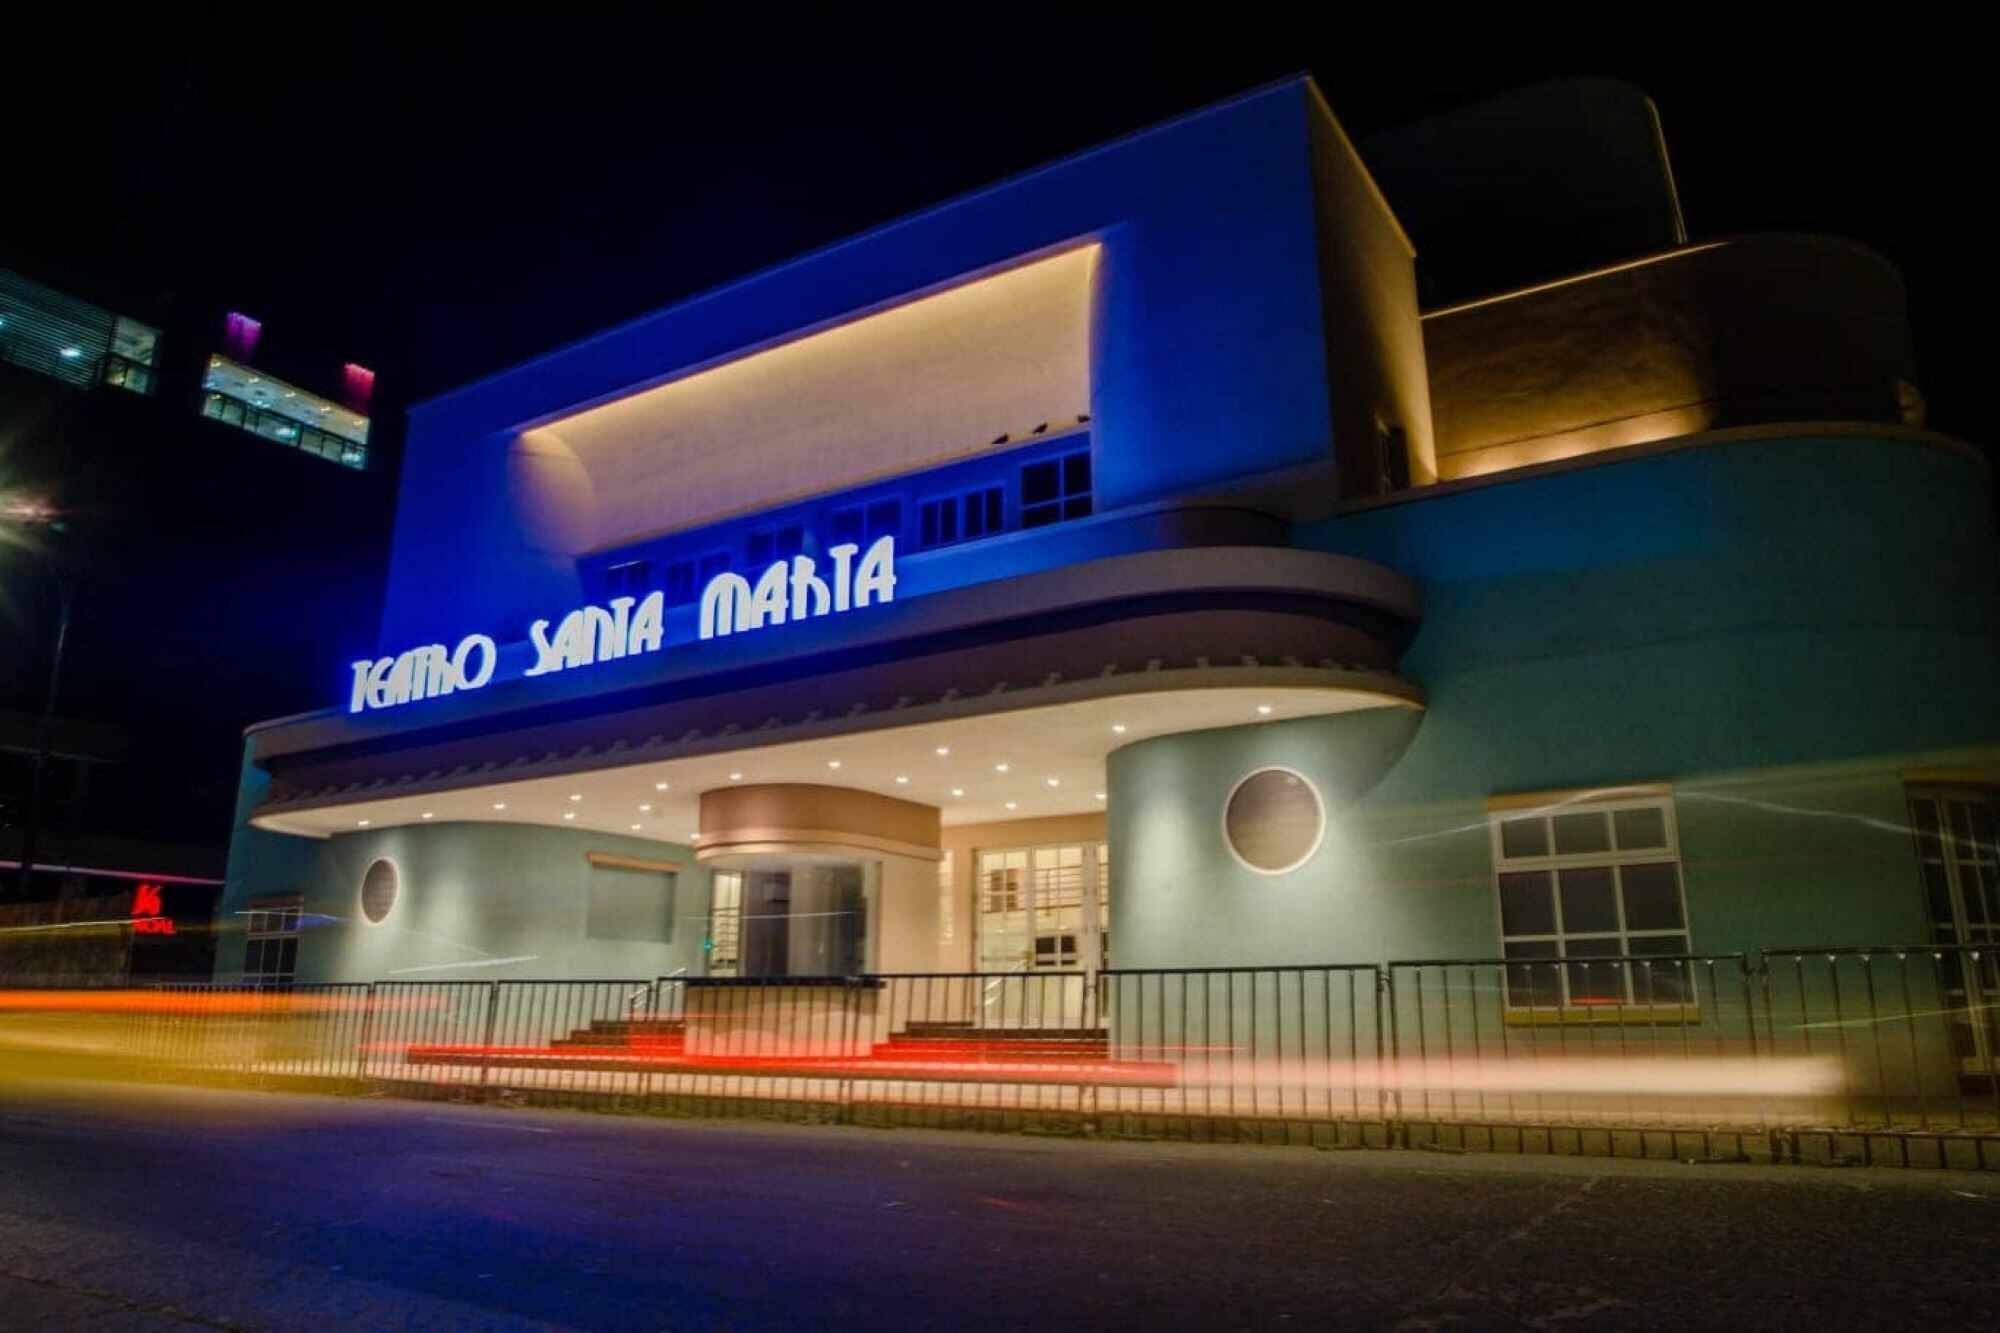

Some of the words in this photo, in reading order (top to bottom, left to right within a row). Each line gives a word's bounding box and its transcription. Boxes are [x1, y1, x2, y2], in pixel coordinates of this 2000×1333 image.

[350, 633, 496, 713] TEATRO
[525, 591, 664, 676] SANTA
[700, 535, 897, 640] MARTA
